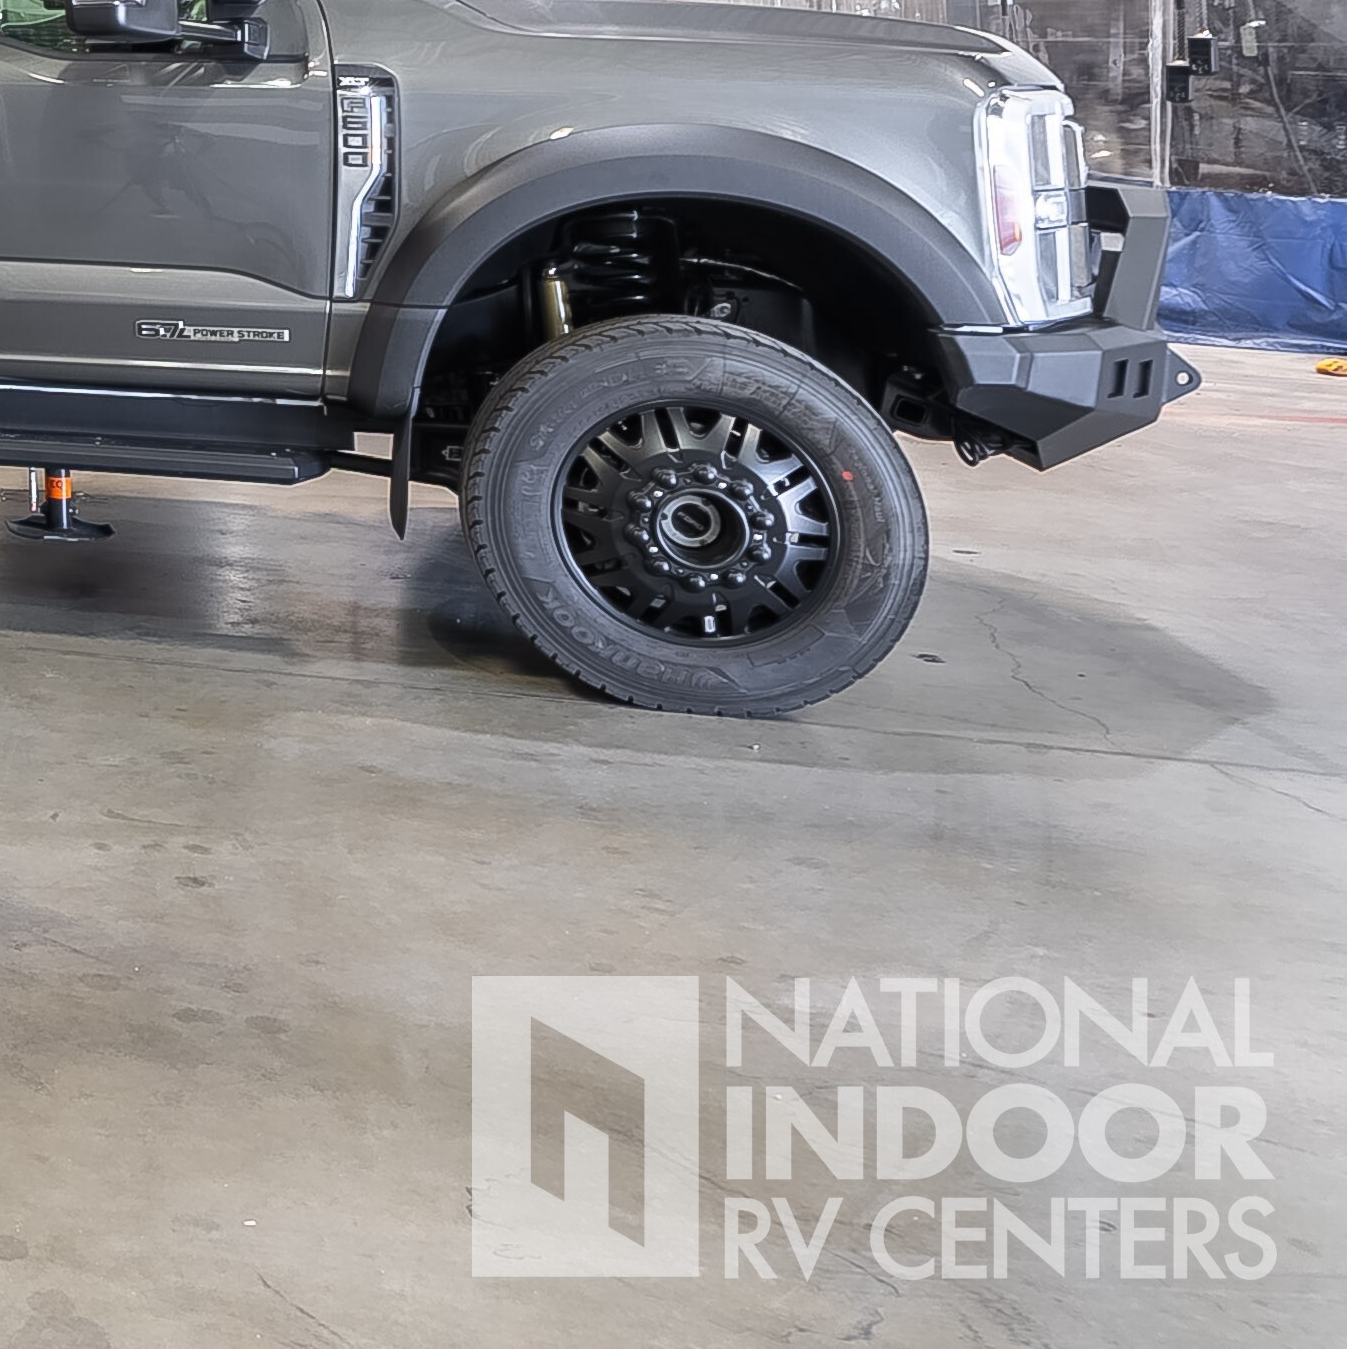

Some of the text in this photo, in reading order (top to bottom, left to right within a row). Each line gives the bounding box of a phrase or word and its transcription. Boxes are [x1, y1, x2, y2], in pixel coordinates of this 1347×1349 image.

[338, 76, 370, 87] XLT
[136, 321, 192, 339] 6.7L
[193, 328, 234, 338] POWER
[237, 329, 285, 340] STROKE
